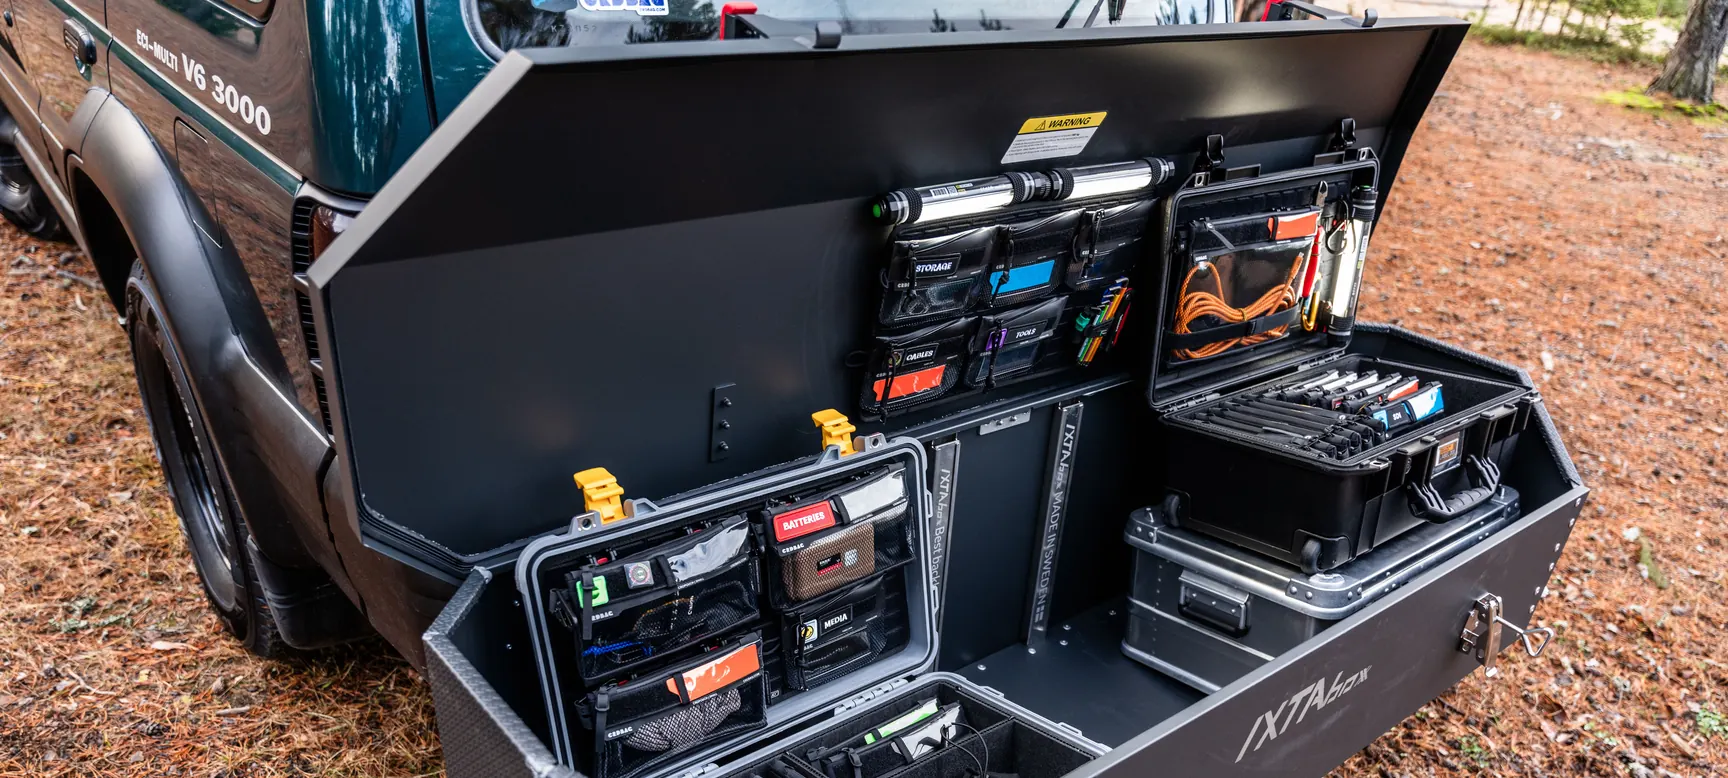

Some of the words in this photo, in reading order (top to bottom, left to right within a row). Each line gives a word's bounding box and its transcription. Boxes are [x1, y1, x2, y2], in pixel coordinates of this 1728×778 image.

[136, 28, 178, 72] ECI-MULTI
[181, 53, 207, 91] V6
[211, 75, 271, 136] 3000
[1047, 117, 1092, 129] WARNING
[915, 262, 953, 272] STORAGE
[1015, 328, 1037, 339] TOOLS
[906, 350, 934, 361] CABLES
[1047, 491, 1064, 533] MADE
[782, 511, 826, 531] BATTERIES
[932, 526, 946, 555] Best
[1046, 533, 1057, 549] IN
[1037, 549, 1054, 606] SWEDEN
[824, 613, 848, 630] MEDIA
